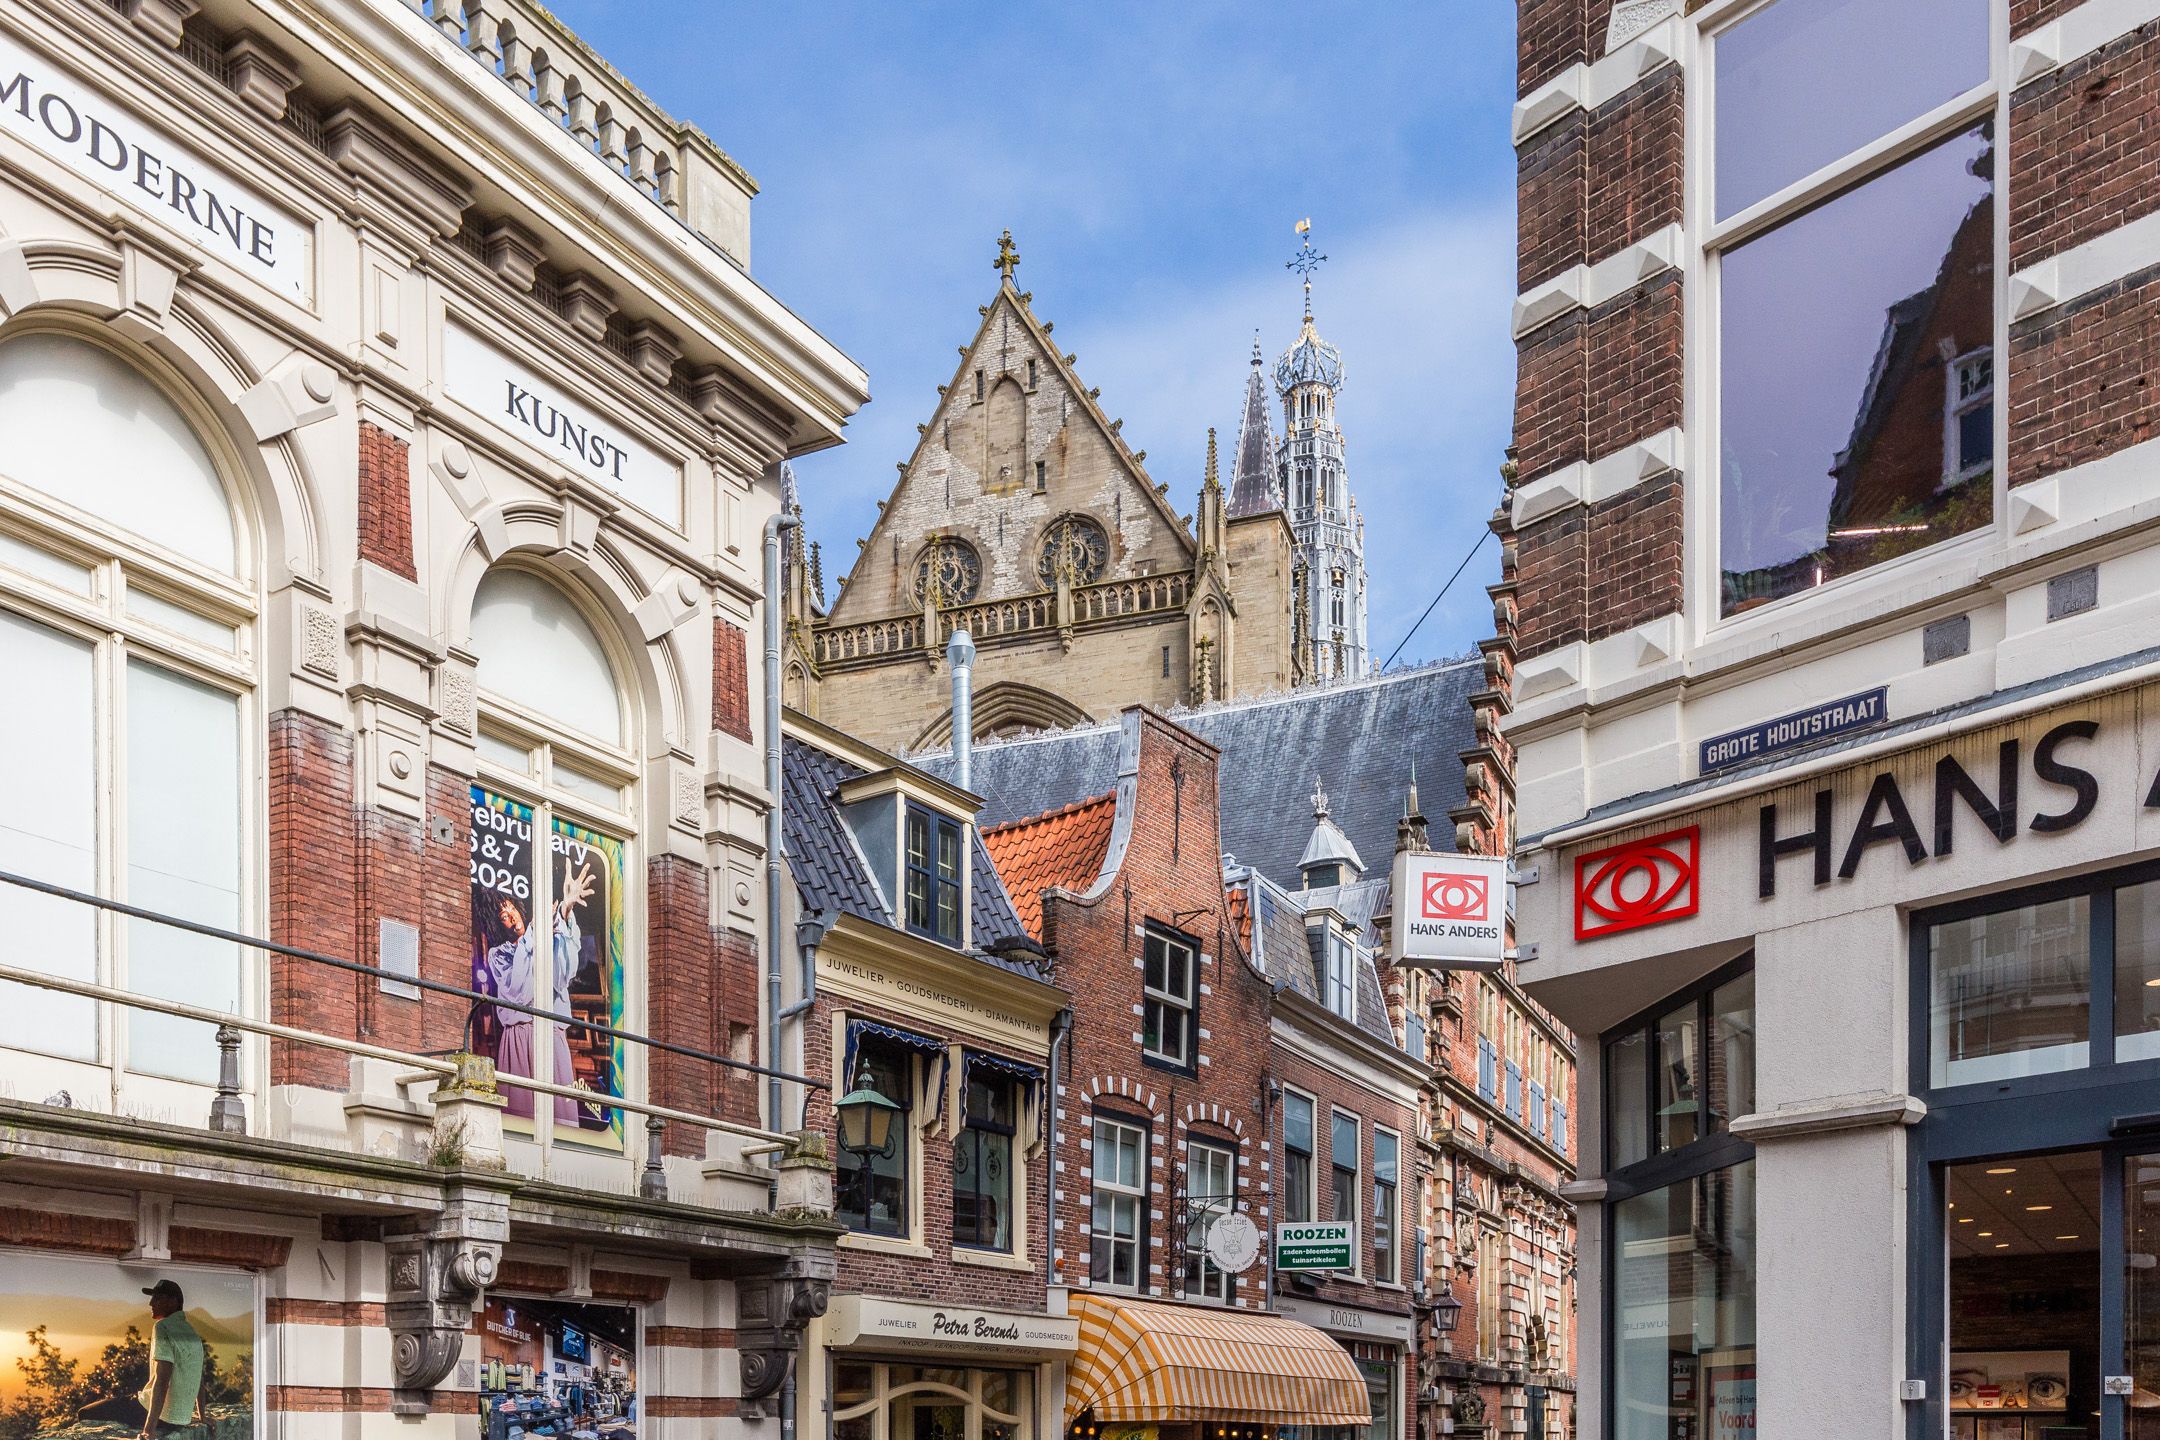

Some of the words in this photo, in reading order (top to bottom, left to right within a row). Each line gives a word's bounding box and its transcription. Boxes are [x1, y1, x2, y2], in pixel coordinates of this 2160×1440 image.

[0, 71, 278, 269] MODERNE
[503, 378, 628, 485] KUNST
[1707, 732, 1760, 764] GROTE
[1767, 696, 1878, 747] HOUTSTRAAT
[1759, 719, 2100, 899] HANS
[481, 834, 503, 862] &
[503, 840, 520, 866] 7
[1410, 923, 1445, 936] HANS
[1448, 925, 1498, 939] ANDERS
[826, 958, 885, 984] JUWELIER
[896, 980, 974, 1013] GOUDSMEDERIJ
[985, 1009, 1042, 1035] DIAMANTAIR
[1283, 1227, 1346, 1241] ROOZEN
[878, 1318, 917, 1329] JUWELIER
[932, 1312, 970, 1335] Petra
[974, 1316, 1020, 1340] Berends
[1024, 1331, 1074, 1342] GOUDSMEDERIJ
[1330, 1309, 1363, 1328] ROOZEN
[898, 1339, 929, 1347] INKOOP
[934, 1341, 970, 1350] VERKOOP
[1719, 1408, 1756, 1429] Voord
